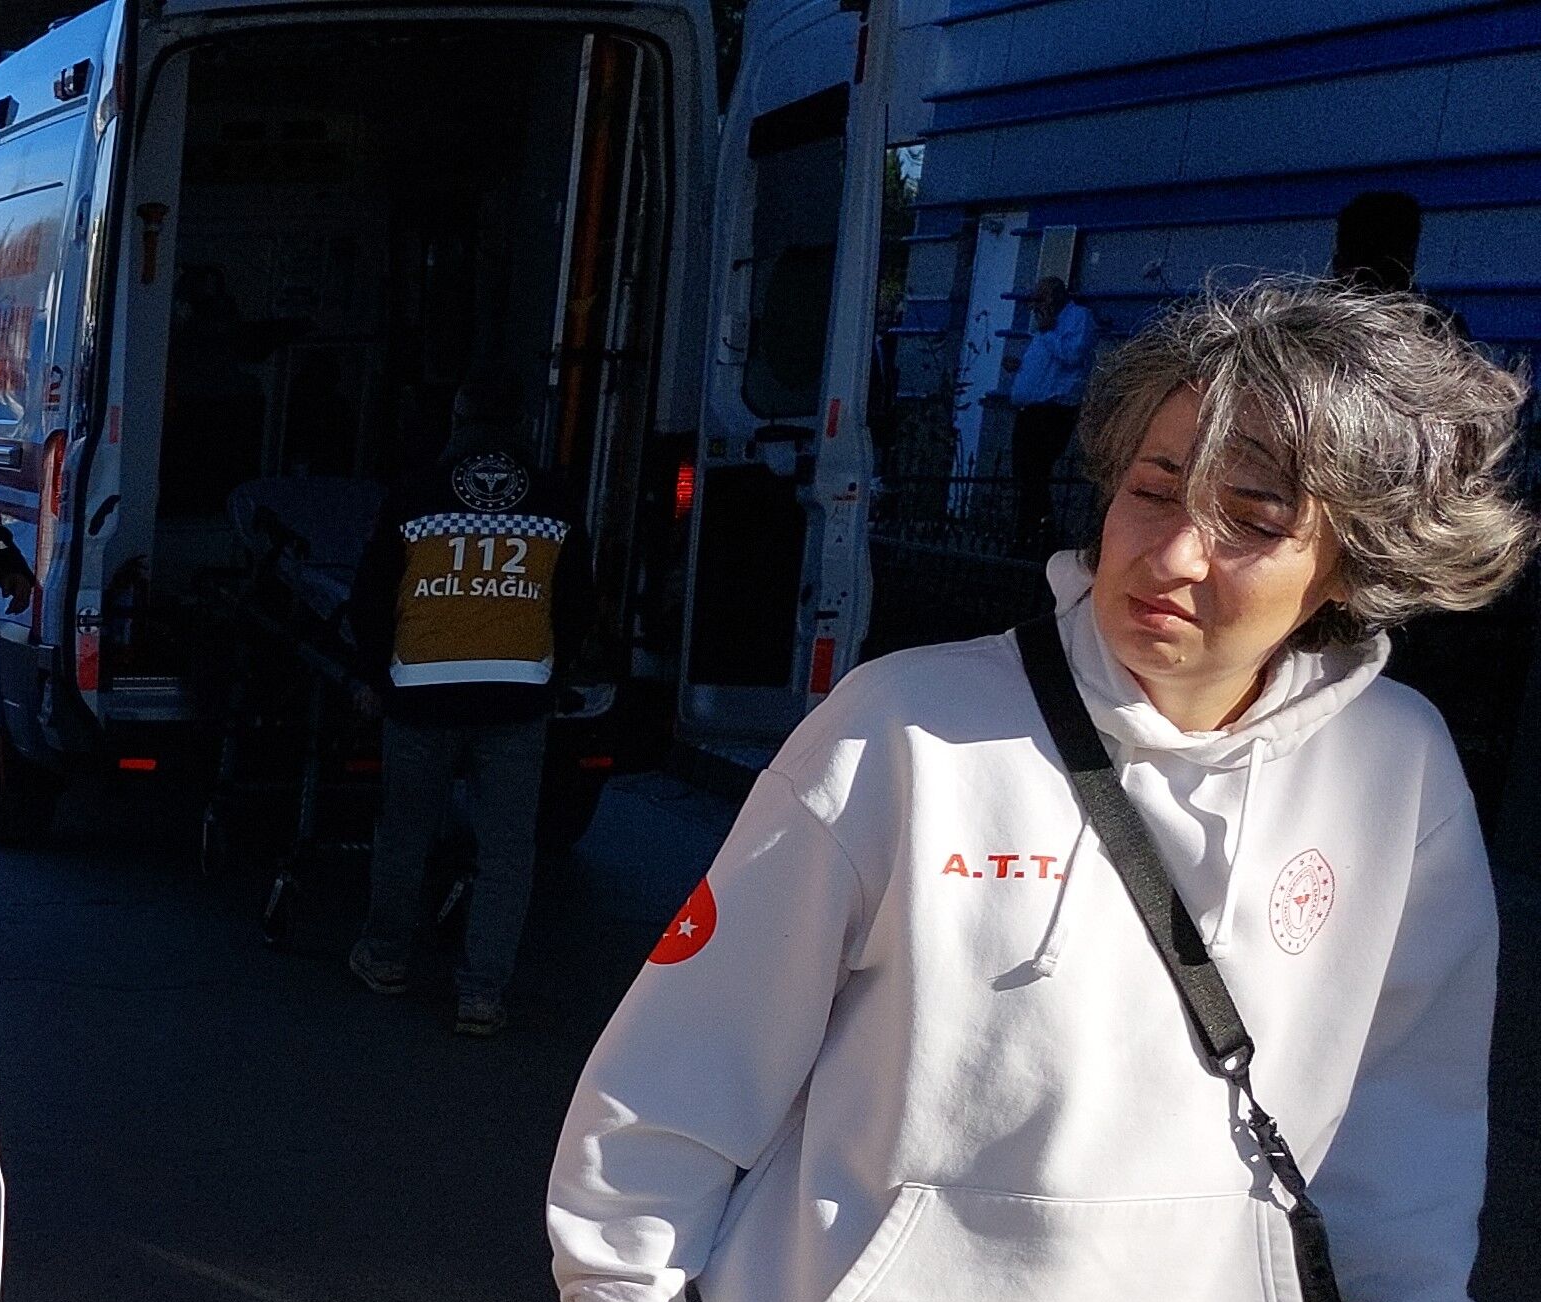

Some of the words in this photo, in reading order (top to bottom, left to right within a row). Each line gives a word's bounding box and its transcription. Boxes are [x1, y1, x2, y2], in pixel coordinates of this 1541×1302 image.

[448, 536, 527, 574] 112
[414, 573, 465, 597] ACİL
[942, 853, 1065, 880] A.T.T.
